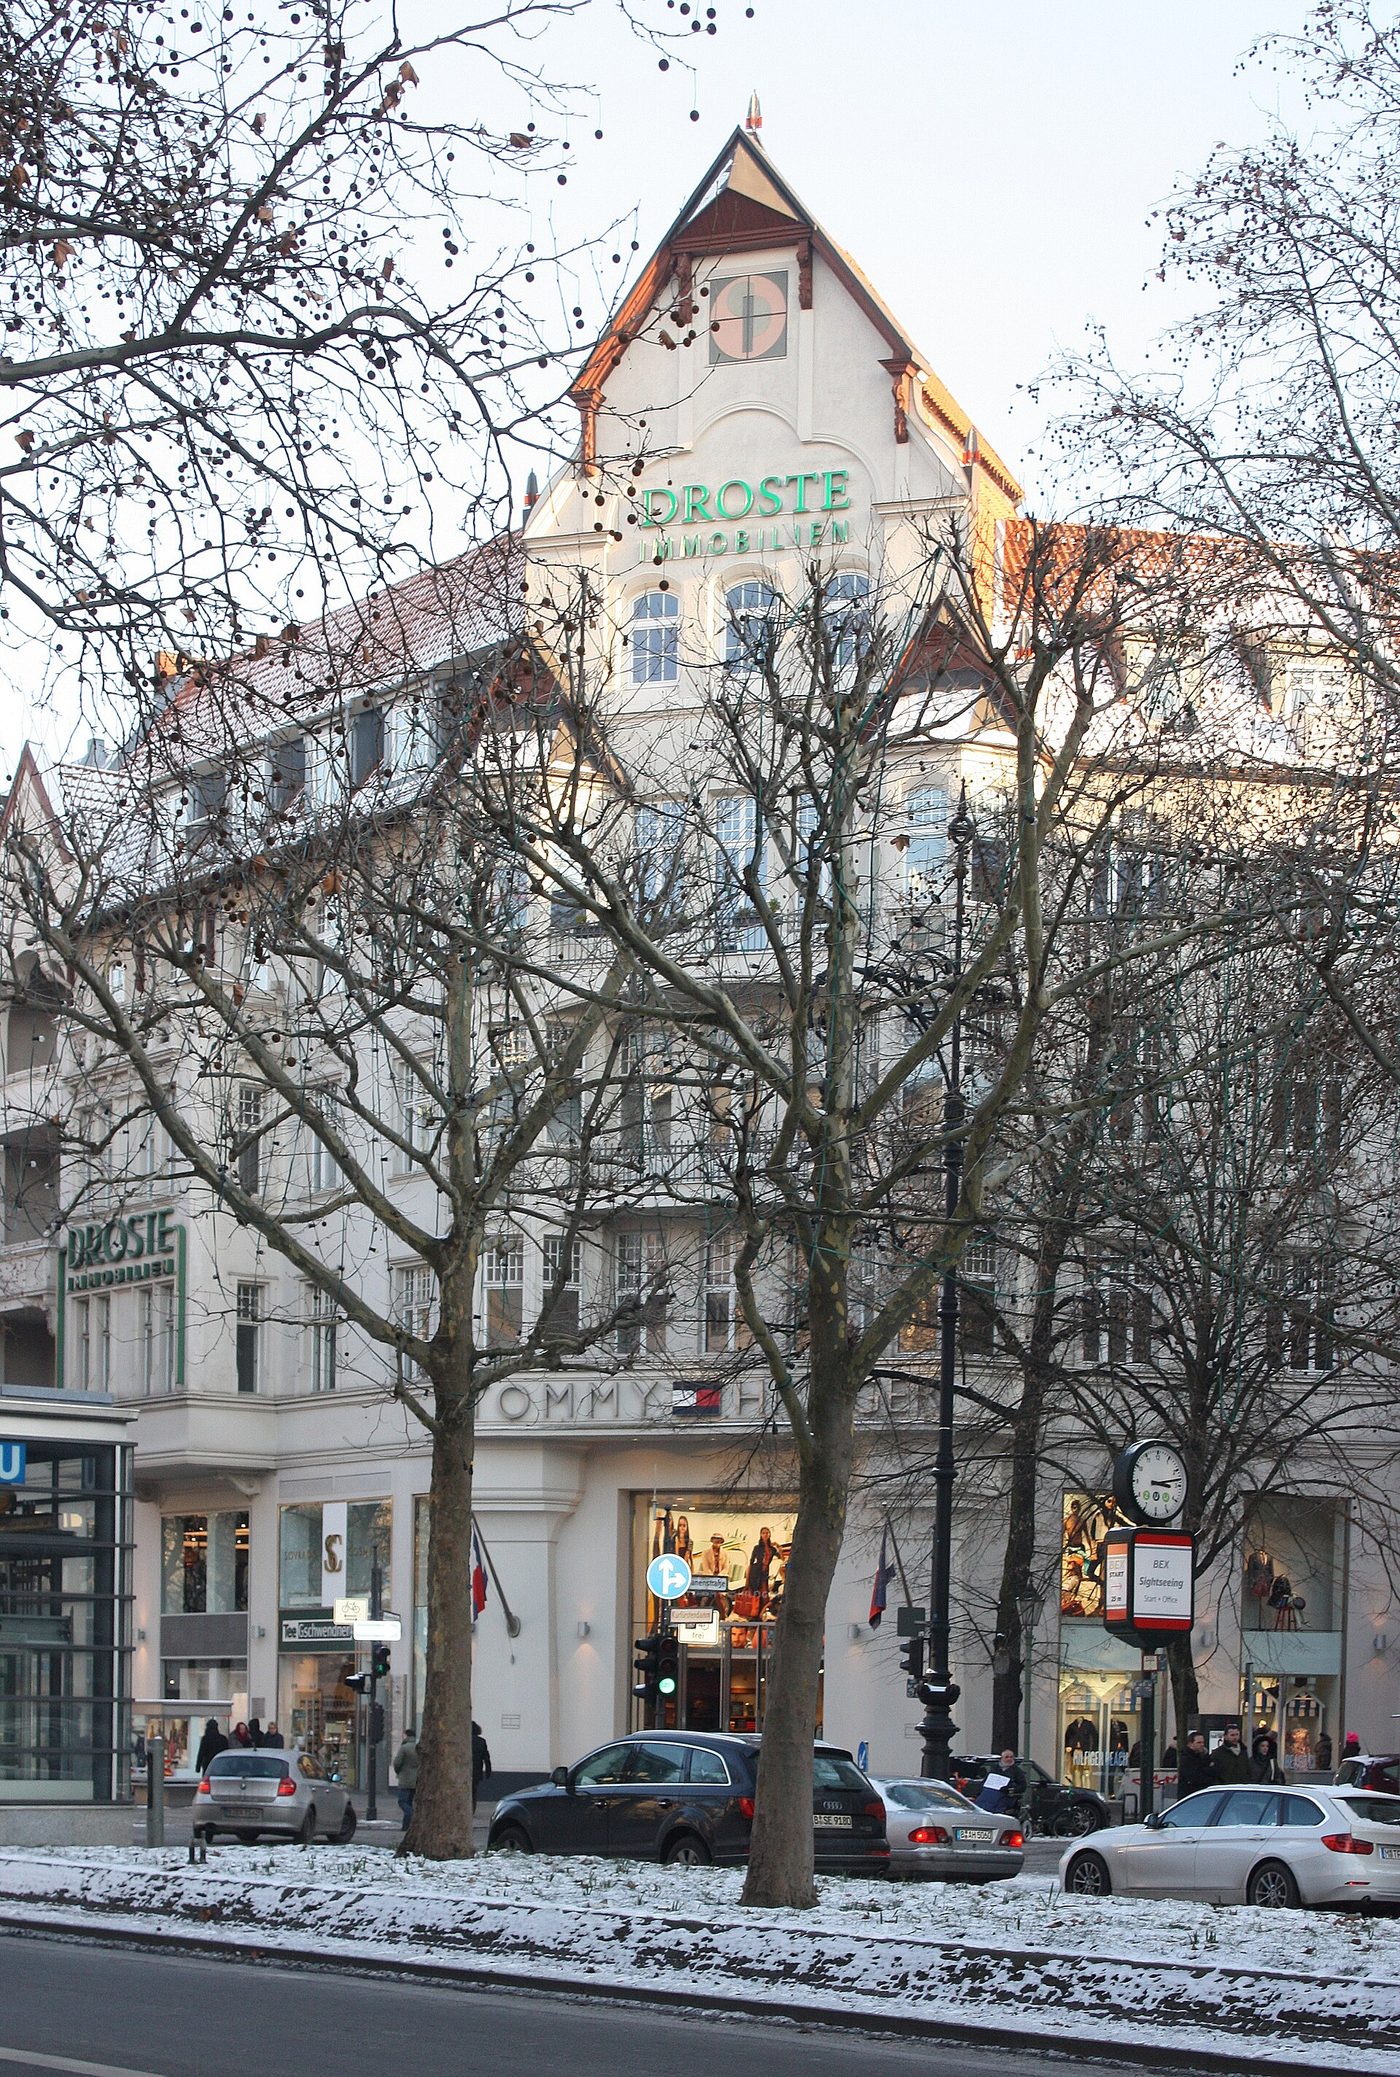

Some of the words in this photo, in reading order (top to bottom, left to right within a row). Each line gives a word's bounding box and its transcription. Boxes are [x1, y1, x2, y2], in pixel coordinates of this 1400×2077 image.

[641, 470, 851, 528] DROSTE
[639, 520, 850, 562] IMMOBILIEN
[67, 1207, 175, 1270] DROSTE
[0, 1444, 20, 1480] U
[1139, 1576, 1184, 1589] Sightseeing
[1153, 1560, 1169, 1569] BEX
[283, 1624, 297, 1638] Tee
